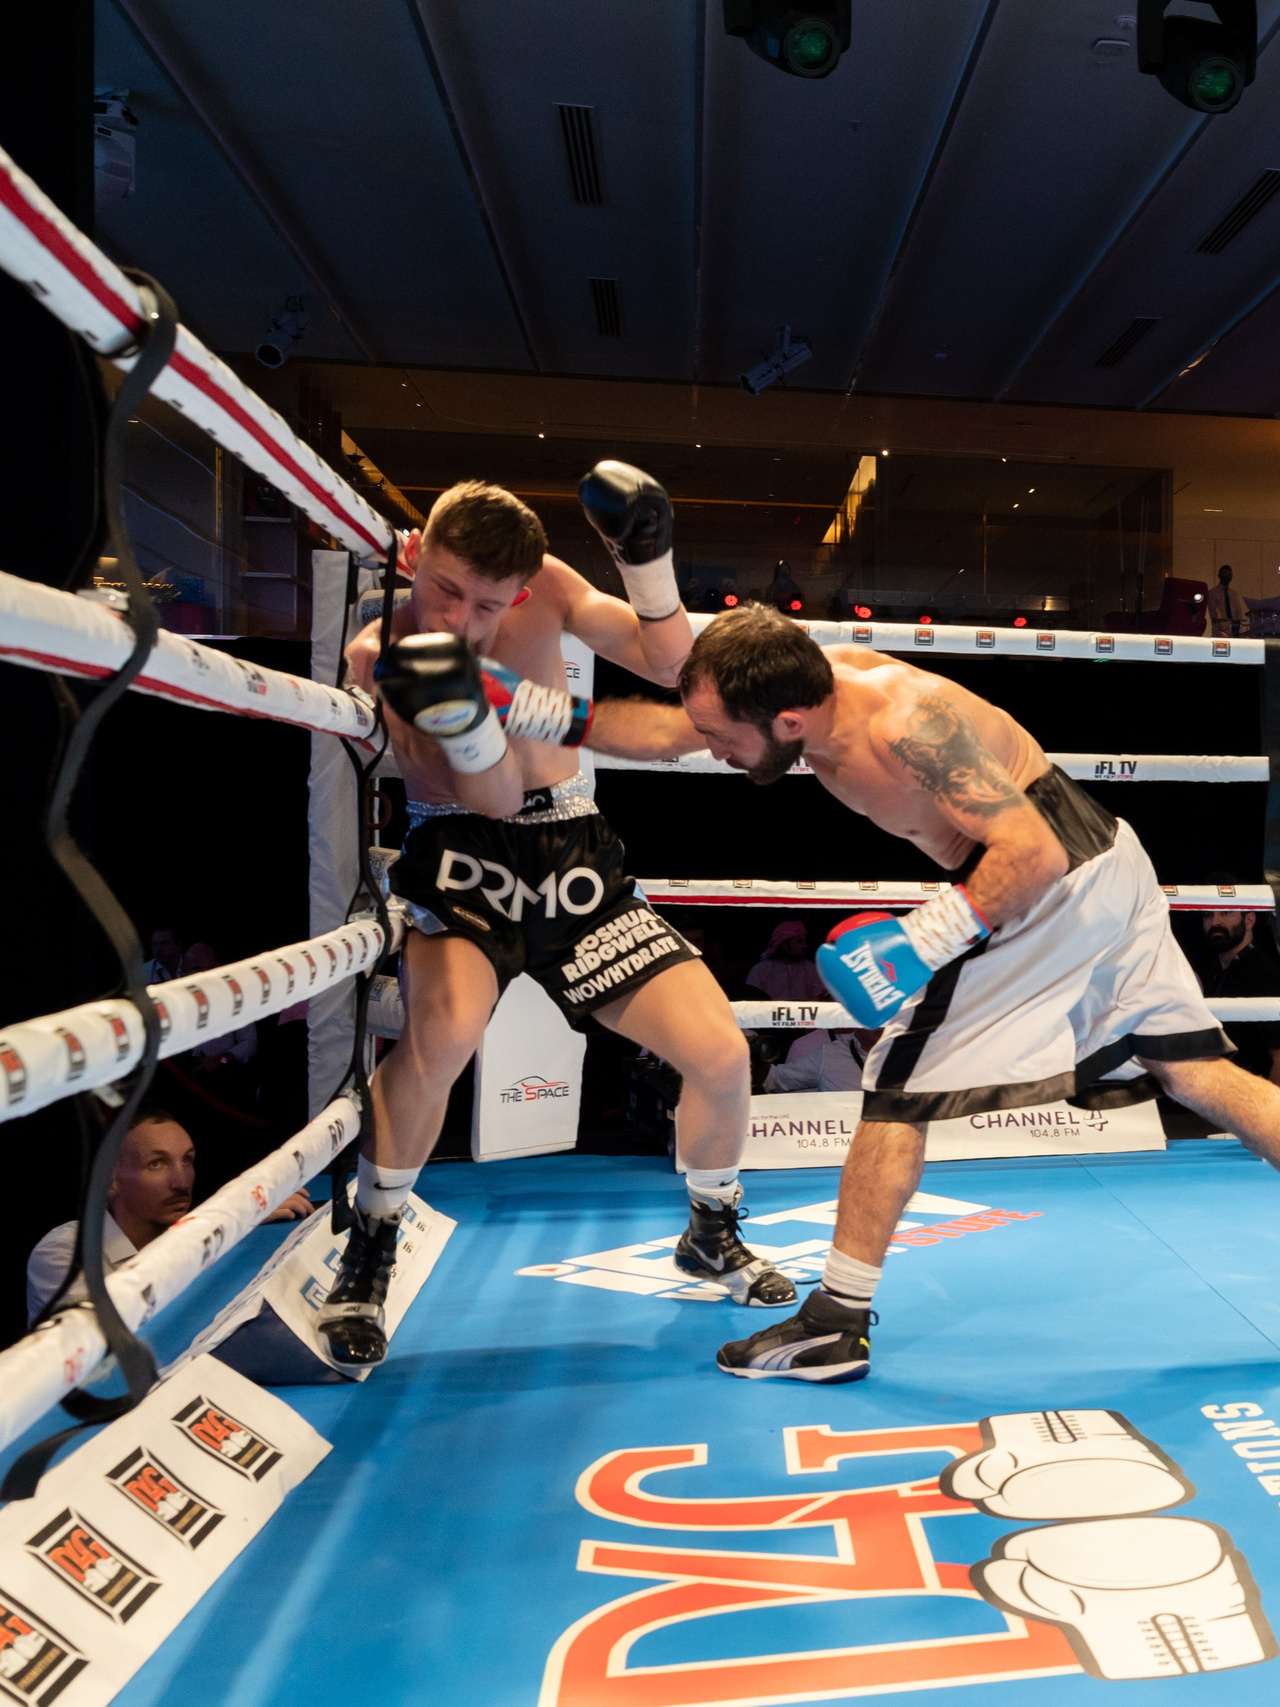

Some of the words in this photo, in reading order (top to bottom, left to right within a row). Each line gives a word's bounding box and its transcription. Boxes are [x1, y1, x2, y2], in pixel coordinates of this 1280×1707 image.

[1119, 760, 1137, 775] TV
[572, 907, 659, 958] JOSHUA
[560, 919, 668, 984] RIDGWELL
[562, 935, 681, 1005] WOWHYDRATE
[839, 940, 906, 1012] EVERLAST
[771, 1006, 795, 1022] iFL
[798, 1006, 819, 1021] TV
[500, 1090, 523, 1104] THE
[524, 1086, 570, 1102] SPACE
[747, 1119, 852, 1138] HANNEL
[969, 1111, 1080, 1130] CHANNEL
[1030, 1129, 1061, 1138] 104.8
[1065, 1128, 1081, 1137] FM
[797, 1138, 829, 1149] 104.8
[834, 1137, 852, 1147] FM
